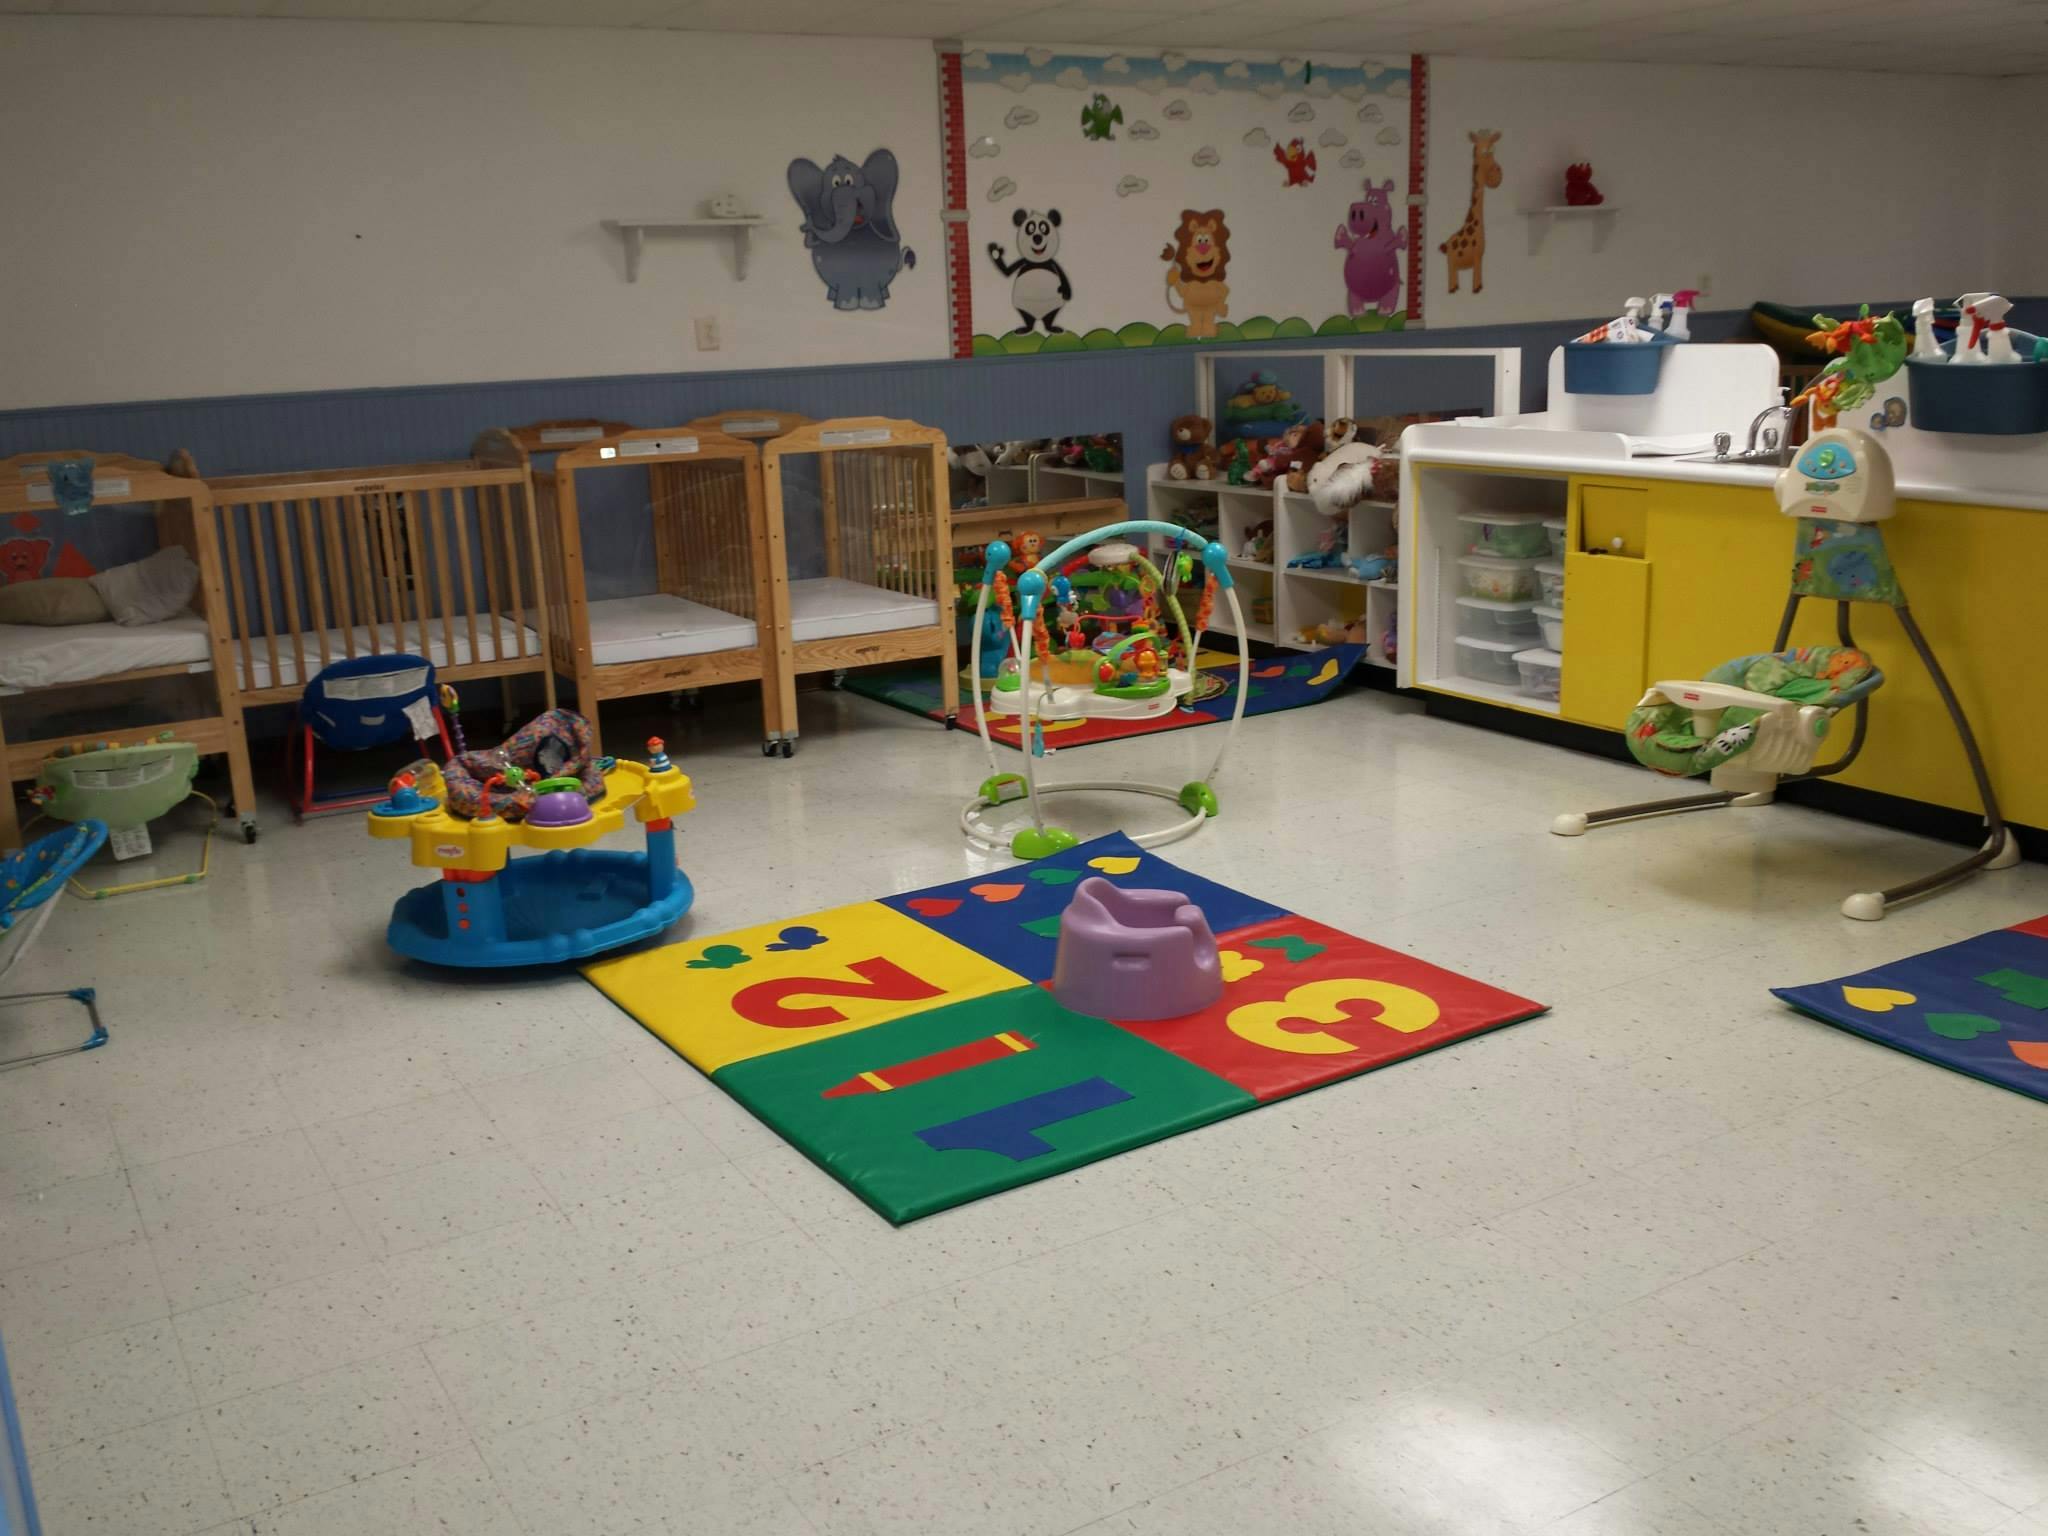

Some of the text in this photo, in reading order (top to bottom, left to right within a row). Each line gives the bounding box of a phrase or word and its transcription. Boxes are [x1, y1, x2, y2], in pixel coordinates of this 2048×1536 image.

[732, 956, 949, 1028] 2
[1227, 979, 1440, 1054] 3
[914, 1076, 1136, 1161] 1
